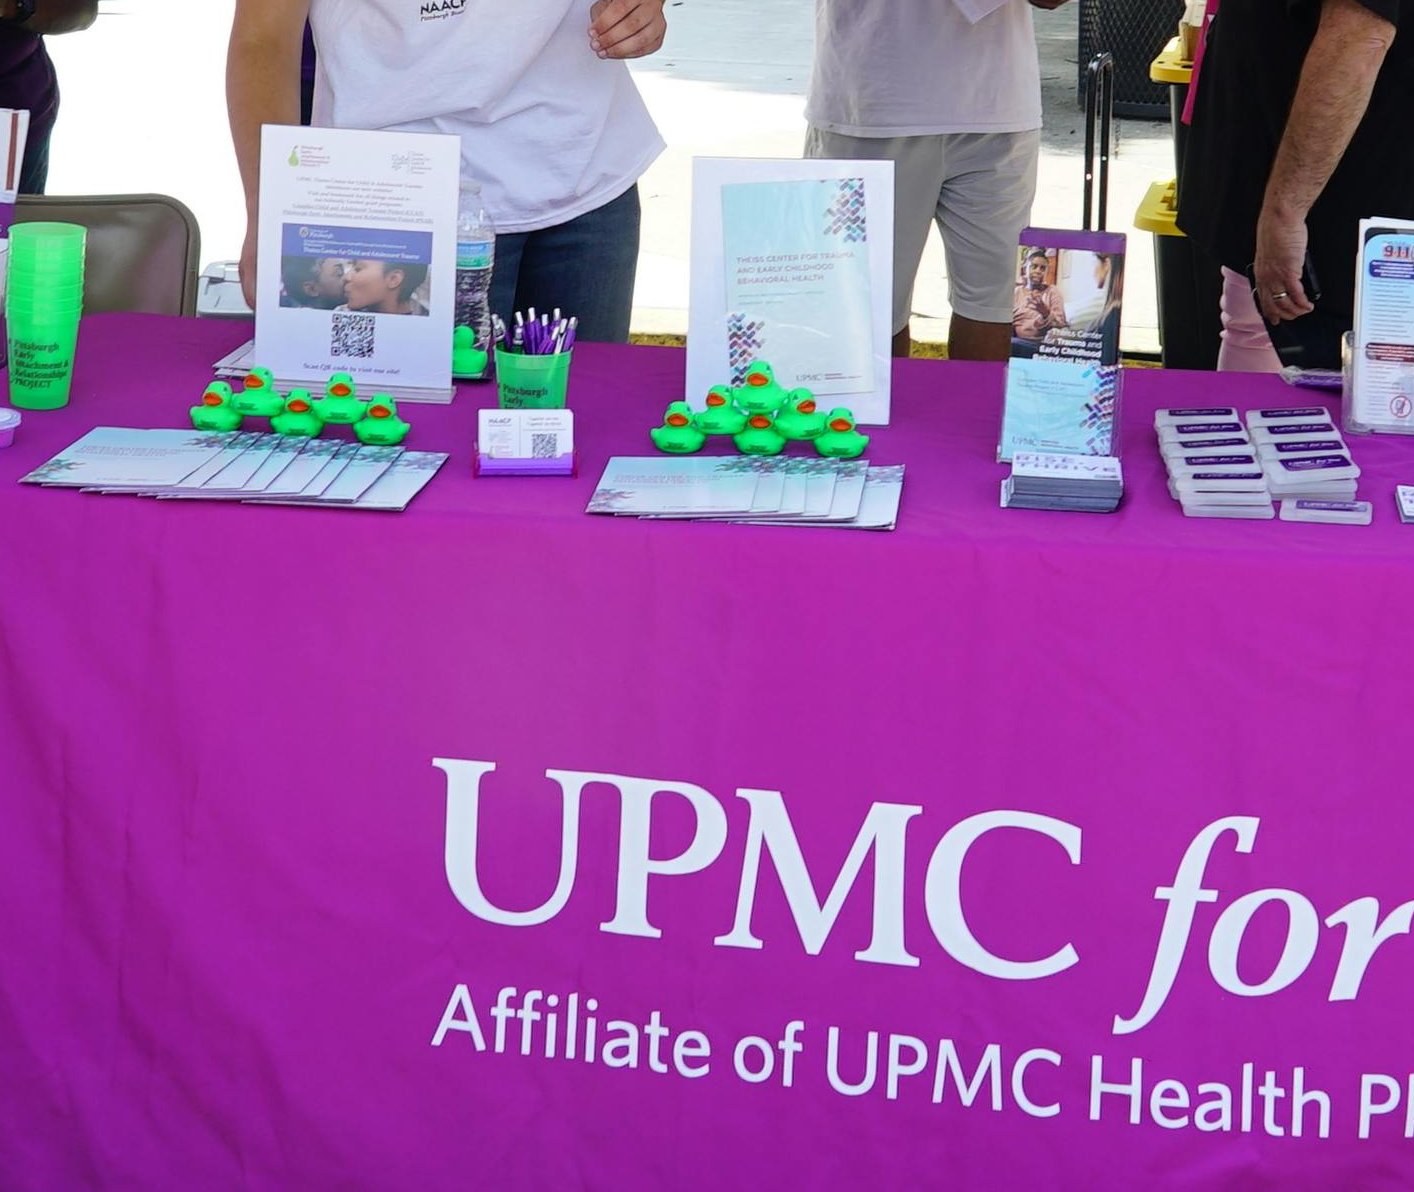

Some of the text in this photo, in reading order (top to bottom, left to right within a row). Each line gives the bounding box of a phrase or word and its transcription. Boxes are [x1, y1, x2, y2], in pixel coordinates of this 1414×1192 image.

[736, 256, 765, 264] THEISS
[766, 254, 799, 263] CENTER
[757, 265, 782, 273] EARLY
[784, 263, 834, 272] CHILDHOOD
[737, 274, 824, 285] BEHAVIORAL HEALTH
[1077, 329, 1103, 340] Center
[14, 339, 59, 353] Pittsburgh
[1057, 338, 1086, 348] Trauma
[1087, 341, 1102, 349] and
[1039, 344, 1102, 358] Early Childhood
[503, 383, 549, 398] Pittsburgh
[431, 756, 1082, 981] UPMC
[431, 982, 712, 1080] Affiliate
[733, 1019, 803, 1089] of
[825, 1028, 1062, 1119] UPMC
[1089, 1056, 1333, 1139] Health
